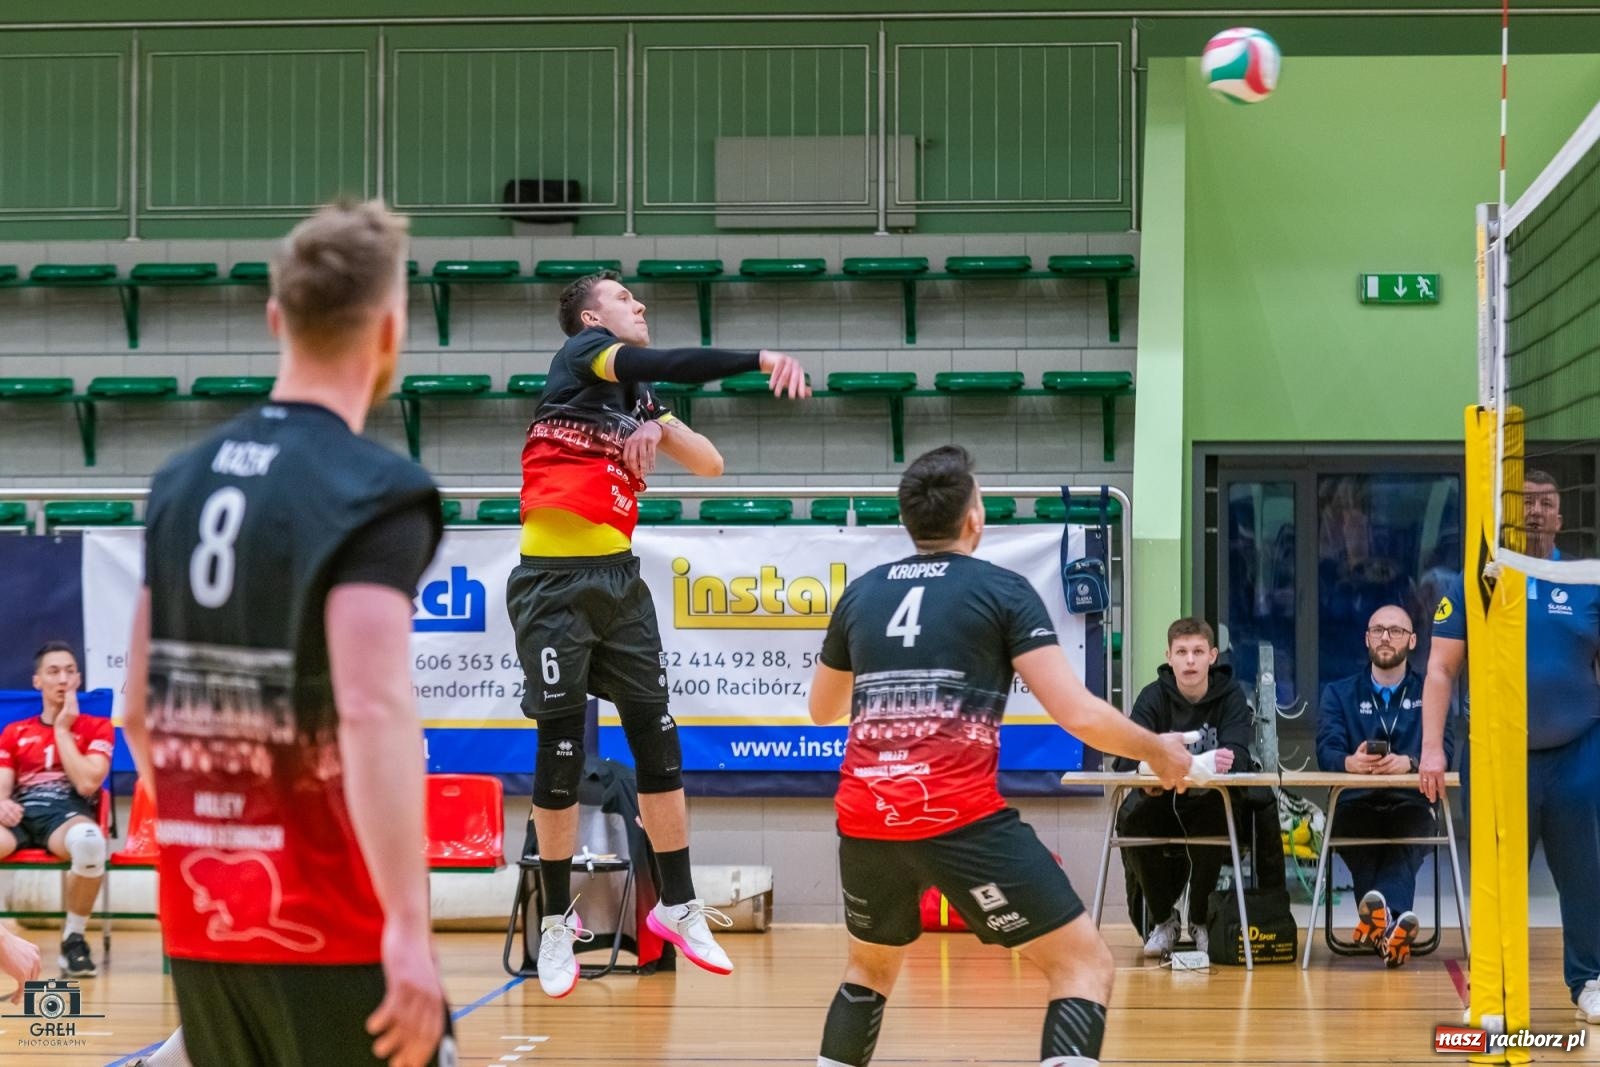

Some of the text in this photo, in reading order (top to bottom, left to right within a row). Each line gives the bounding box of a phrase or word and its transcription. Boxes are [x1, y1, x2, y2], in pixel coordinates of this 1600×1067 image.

[189, 485, 247, 609] 8
[887, 561, 950, 580] KROPISZ
[412, 566, 486, 632] ch
[671, 556, 848, 630] instal
[885, 586, 926, 648] 4
[415, 653, 451, 670] 606
[457, 653, 494, 671] 363
[540, 646, 561, 685] 6
[688, 652, 726, 668] 414
[731, 652, 756, 668] 92
[762, 651, 792, 670] 88,
[716, 677, 807, 697] Racibórz,
[43, 744, 55, 769] 1
